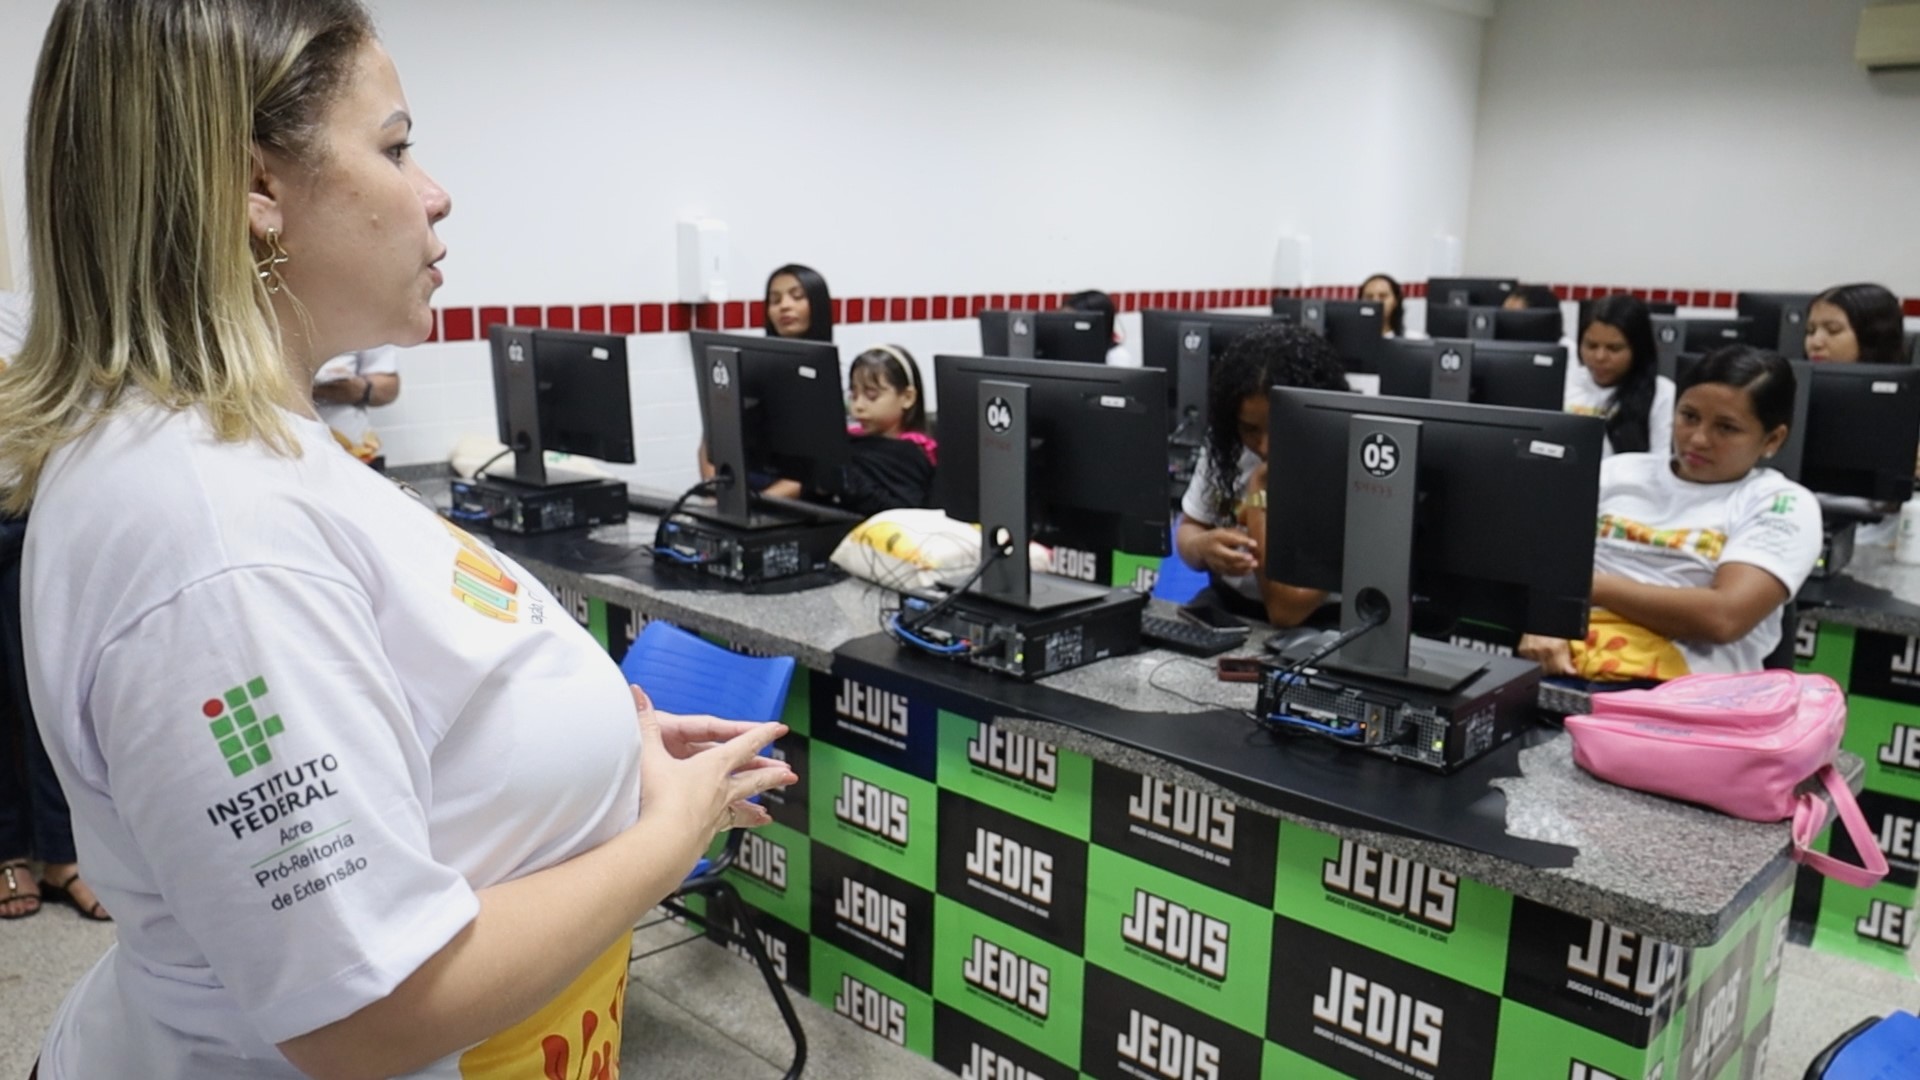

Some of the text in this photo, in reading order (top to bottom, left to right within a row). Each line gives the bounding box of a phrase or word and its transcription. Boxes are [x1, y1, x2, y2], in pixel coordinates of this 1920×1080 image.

[508, 344, 524, 362] 02
[987, 404, 1011, 428] 04
[1363, 443, 1396, 471] 05
[206, 754, 338, 826] INSTITUTO
[229, 779, 338, 840] FEDERAL
[835, 774, 909, 844] JEDIS
[254, 832, 355, 888] Pró-Reitoria
[280, 819, 314, 846] Acre
[734, 831, 786, 889] EDIS
[271, 855, 368, 912] de Extensão
[966, 827, 1053, 904] JEDIS
[835, 876, 907, 947] JEDIS
[1121, 889, 1229, 979] JEDIS
[963, 936, 1050, 1016] JEDIS
[835, 975, 906, 1046] JEDIS
[1312, 966, 1444, 1068] JEDIS
